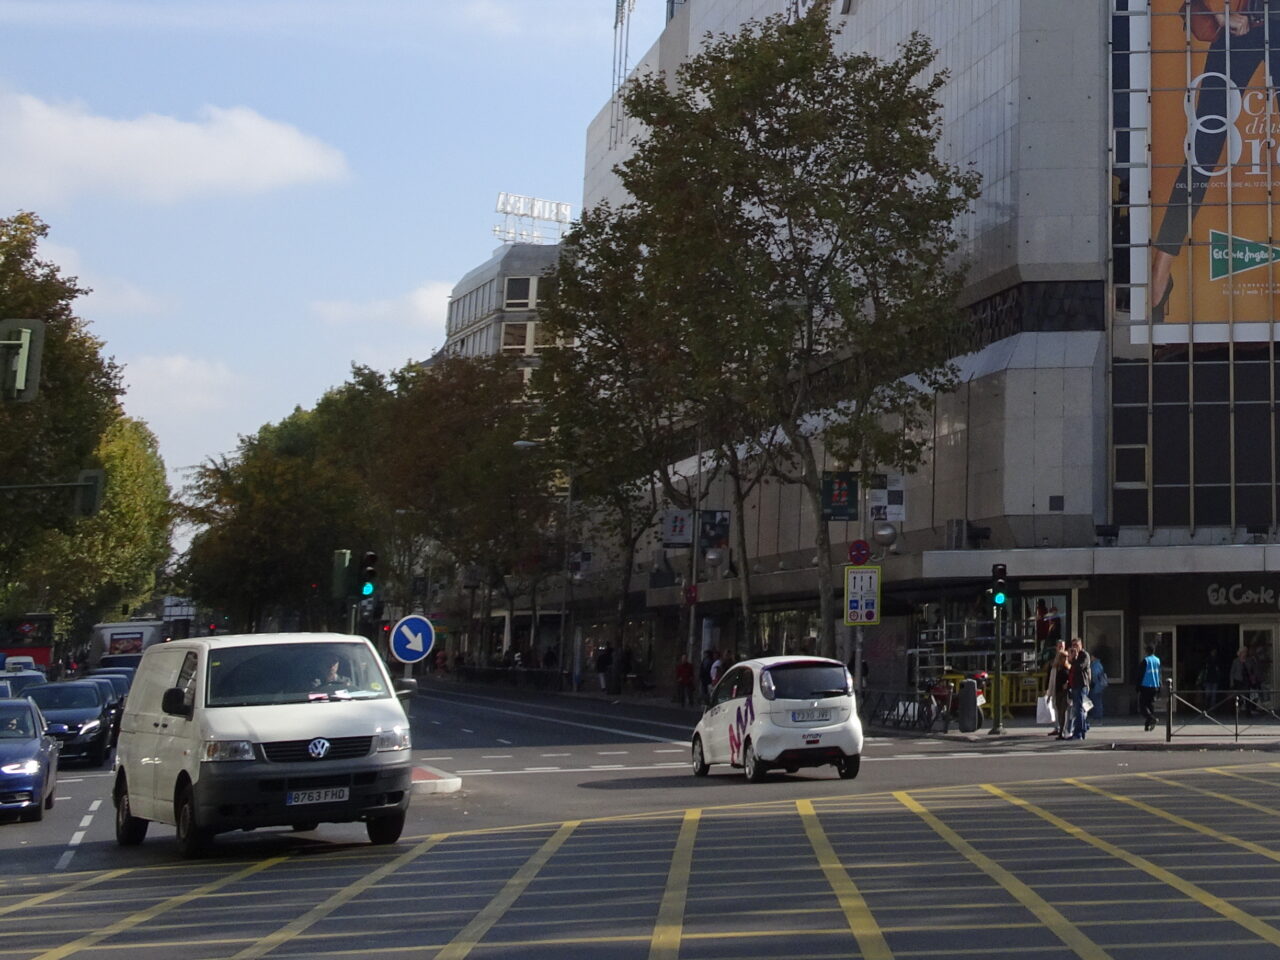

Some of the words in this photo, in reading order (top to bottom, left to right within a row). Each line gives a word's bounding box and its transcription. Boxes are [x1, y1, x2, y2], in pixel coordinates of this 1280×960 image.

[1223, 248, 1244, 259] Crte
[1206, 583, 1228, 605] El
[1228, 583, 1275, 605] Corte
[293, 792, 321, 803] 8763
